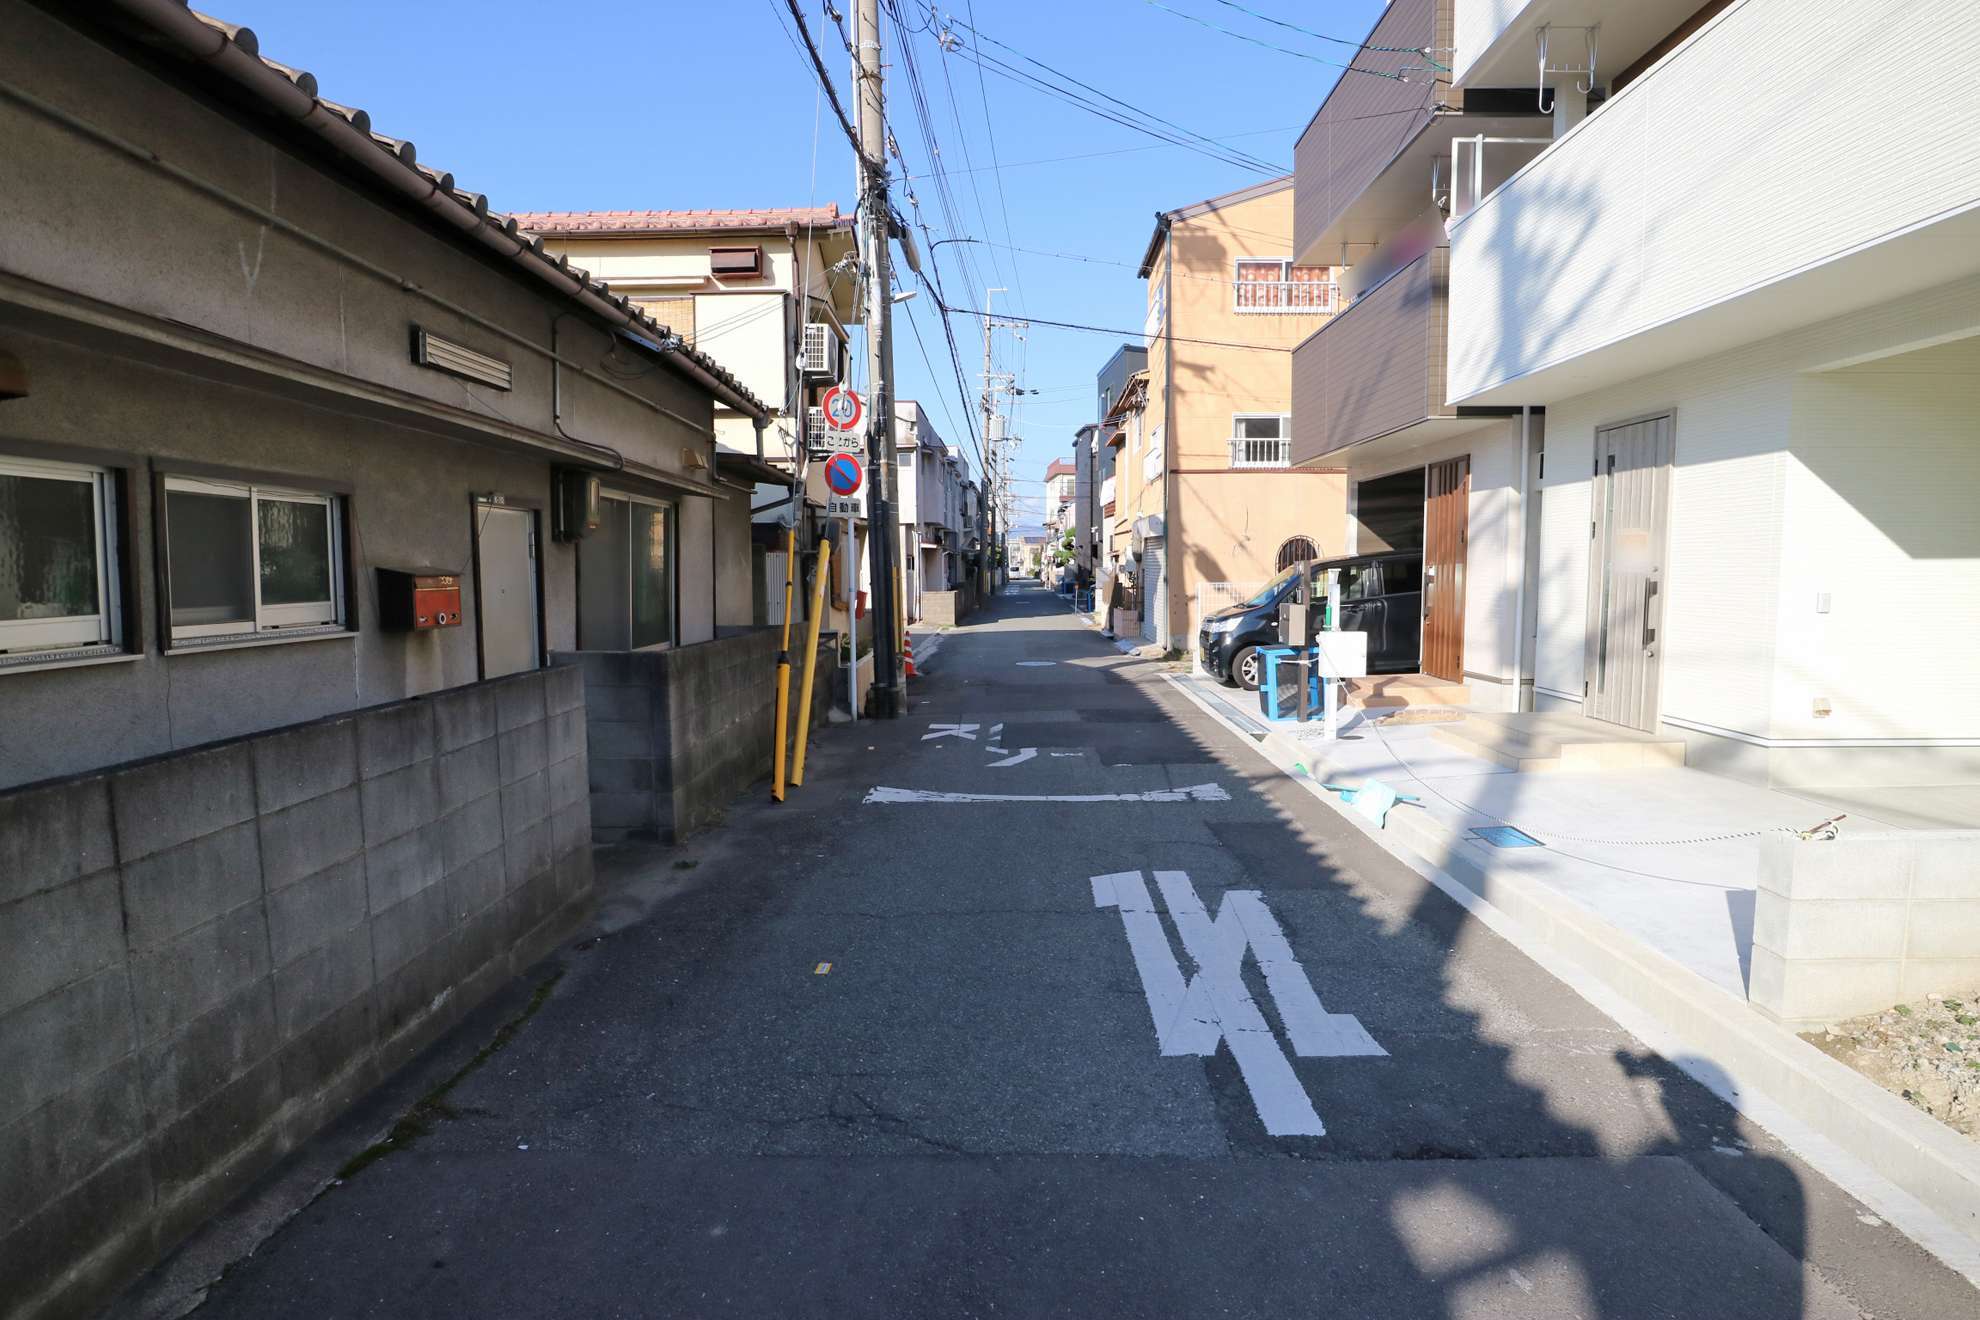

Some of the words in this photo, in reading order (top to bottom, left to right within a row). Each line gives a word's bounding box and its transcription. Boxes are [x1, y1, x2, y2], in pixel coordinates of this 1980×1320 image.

[832, 398, 853, 417] 20
[828, 502, 860, 513] 自動車
